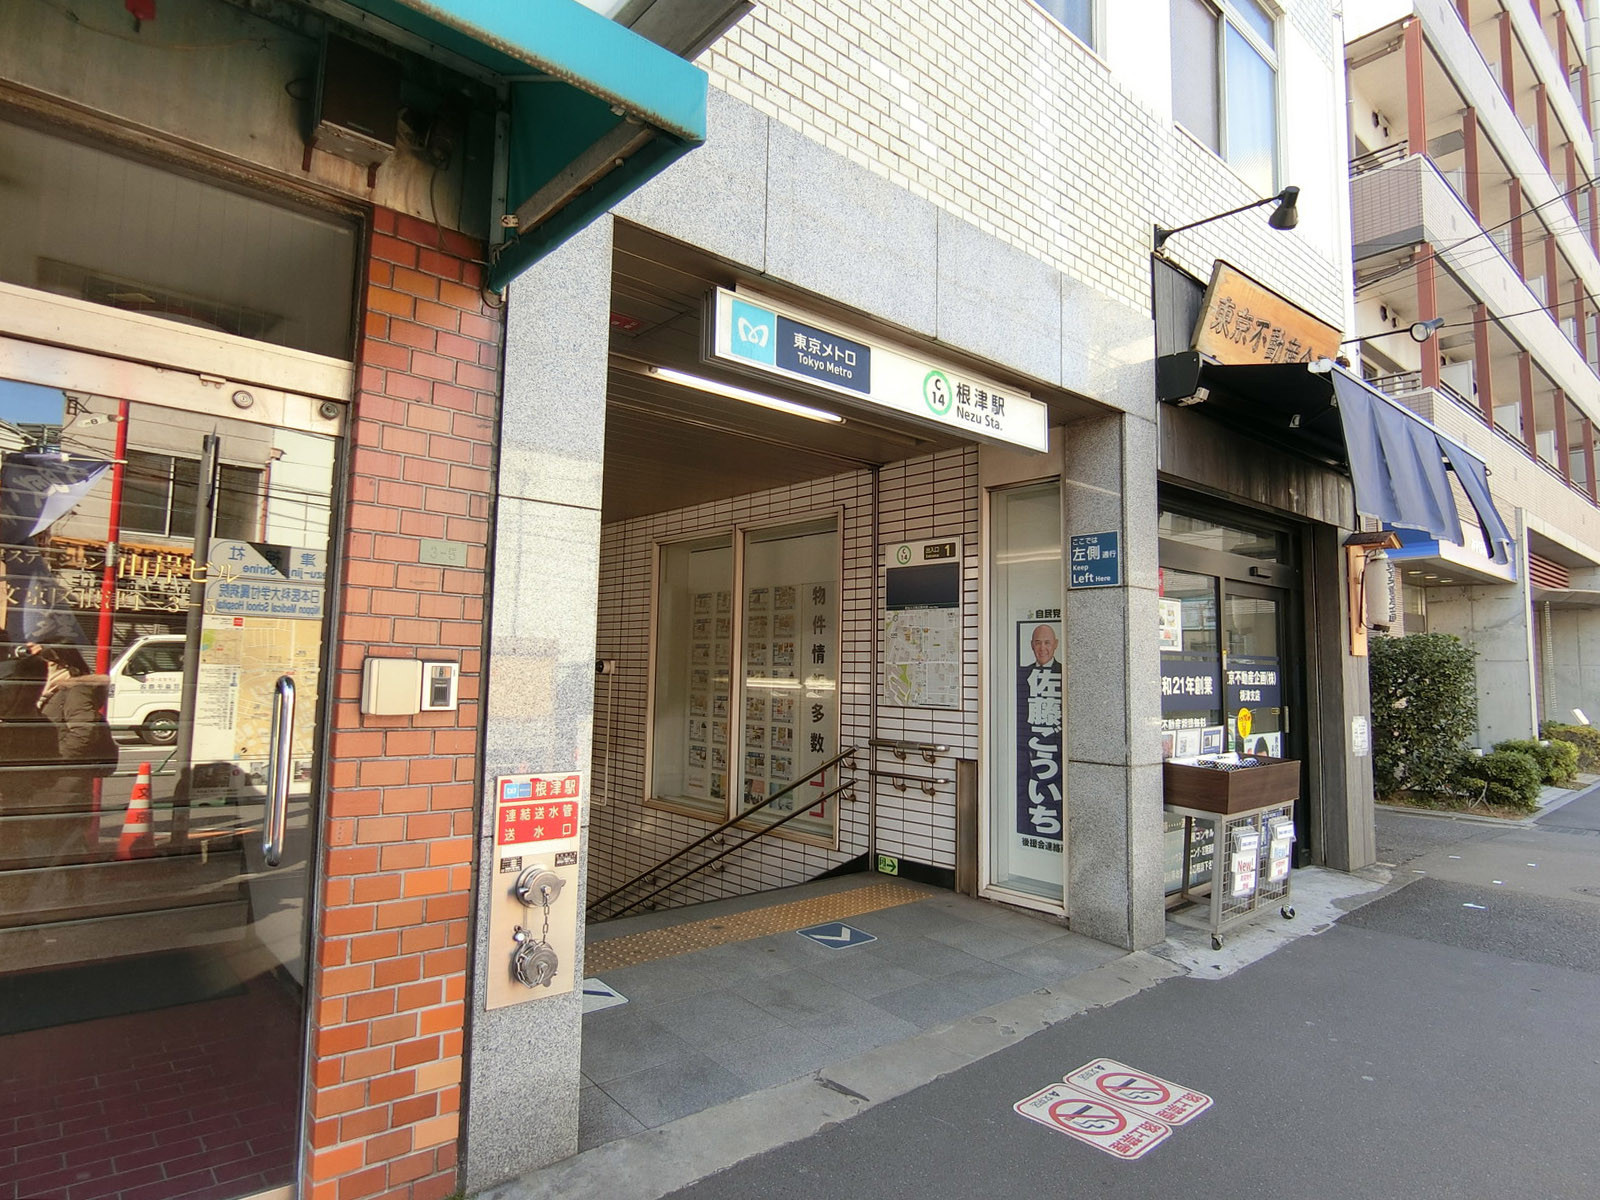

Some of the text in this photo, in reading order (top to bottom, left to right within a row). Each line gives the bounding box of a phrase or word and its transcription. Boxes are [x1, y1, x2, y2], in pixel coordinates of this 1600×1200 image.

[1210, 296, 1330, 363] 東京不動産
[793, 332, 856, 366] 東京メトロ
[797, 352, 853, 379] Tokyo Metro
[935, 378, 942, 391] C
[933, 393, 945, 407] 14
[956, 382, 1005, 417] 根津駅
[956, 406, 1004, 431] Nezu Sta.
[944, 544, 950, 556] 1
[1072, 537, 1098, 545] ここでは
[1073, 573, 1094, 584] Left
[1035, 608, 1061, 619] 自民党
[1160, 676, 1213, 696] 和21年創業
[535, 779, 576, 797] 根津駅
[505, 804, 573, 823] 連結送水管
[504, 823, 572, 841] 送水口
[1108, 1121, 1162, 1154] 路上禁煙
